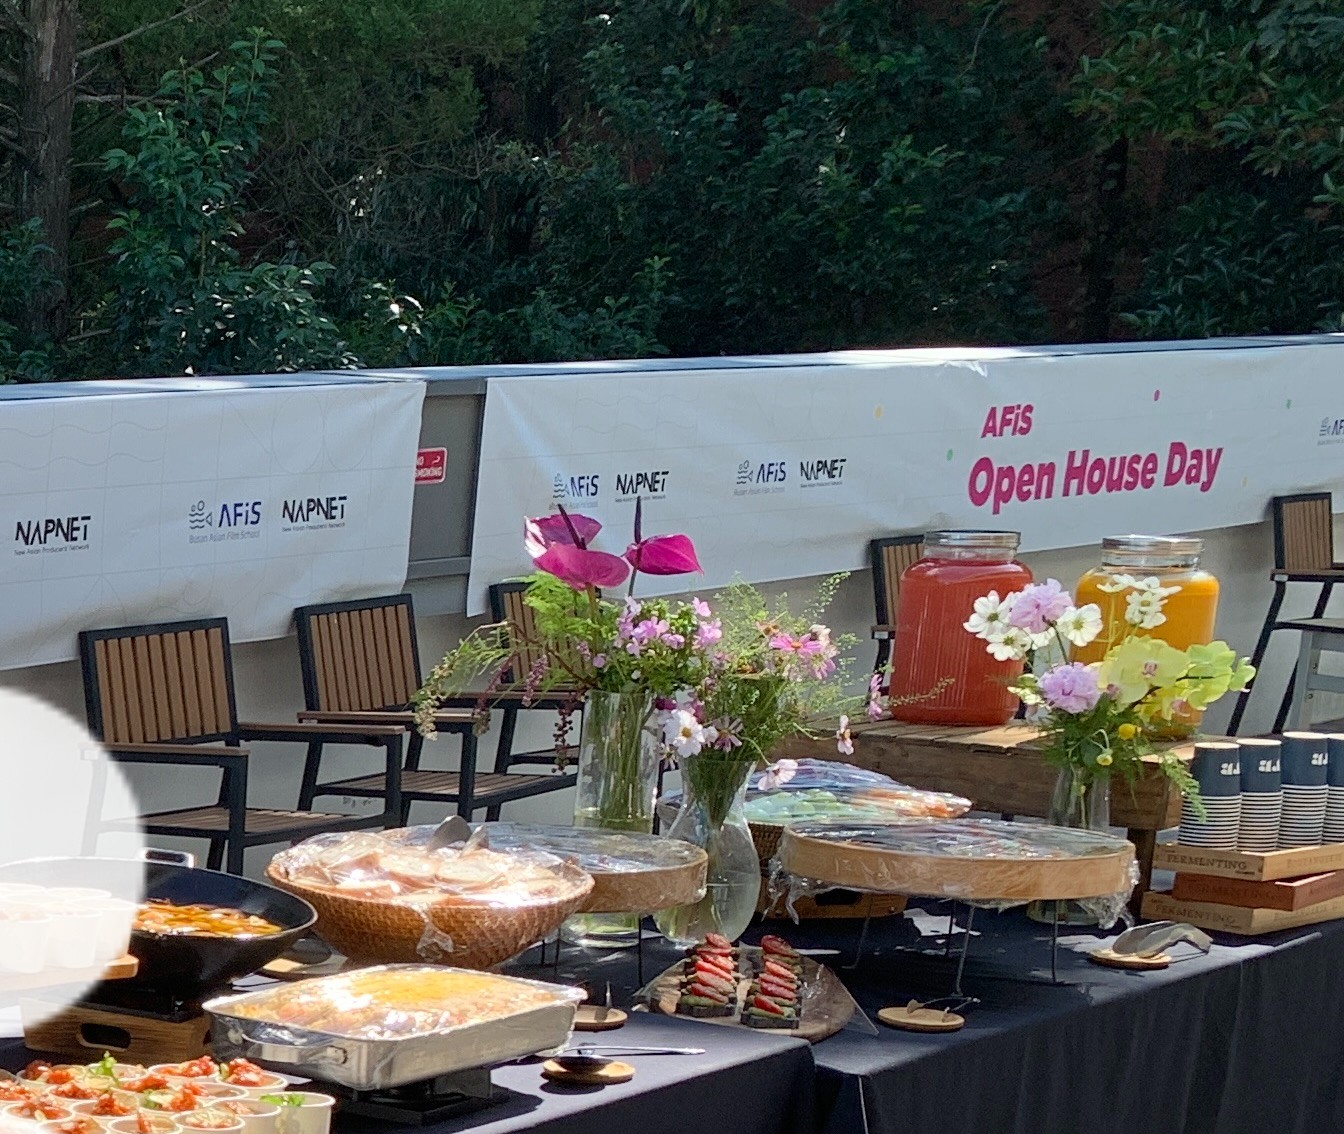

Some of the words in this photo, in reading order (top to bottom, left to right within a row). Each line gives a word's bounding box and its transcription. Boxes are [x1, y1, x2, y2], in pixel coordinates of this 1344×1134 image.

[981, 404, 1034, 438] AFiS
[615, 470, 670, 495] NAPNET
[756, 461, 786, 484] AFiS
[800, 458, 847, 481] NAPNET
[968, 456, 1056, 515] Open
[1062, 449, 1159, 497] House
[1164, 441, 1224, 493] Day
[218, 501, 262, 528] AFiS
[282, 496, 348, 524] NAPNET
[14, 515, 92, 546] NAPNET
